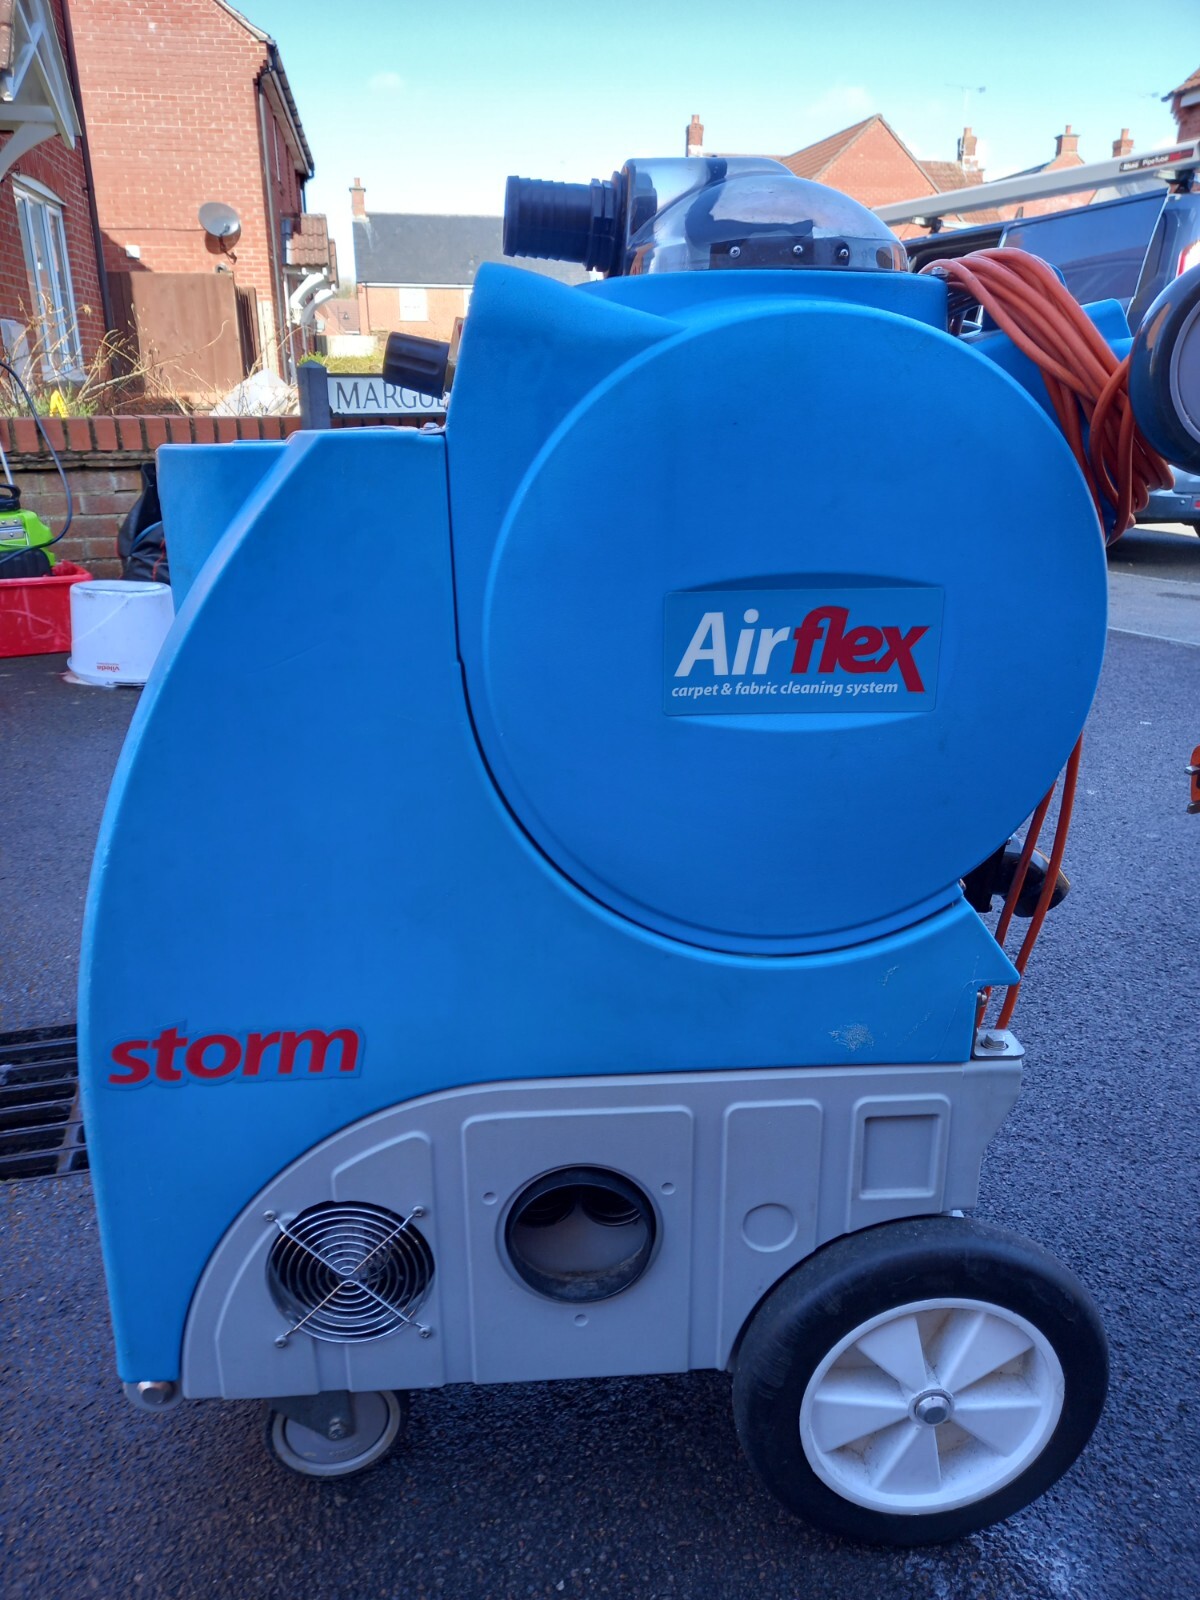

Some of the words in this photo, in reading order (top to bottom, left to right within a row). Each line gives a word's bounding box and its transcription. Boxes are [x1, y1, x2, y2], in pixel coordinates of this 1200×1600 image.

[336, 381, 445, 409] MARGU
[674, 605, 930, 693] Airflex
[671, 684, 719, 699] carpet
[720, 682, 733, 695] &
[735, 681, 778, 695] fabric
[780, 681, 844, 697] cleaning
[845, 681, 898, 697] system
[108, 1026, 359, 1085] storm
